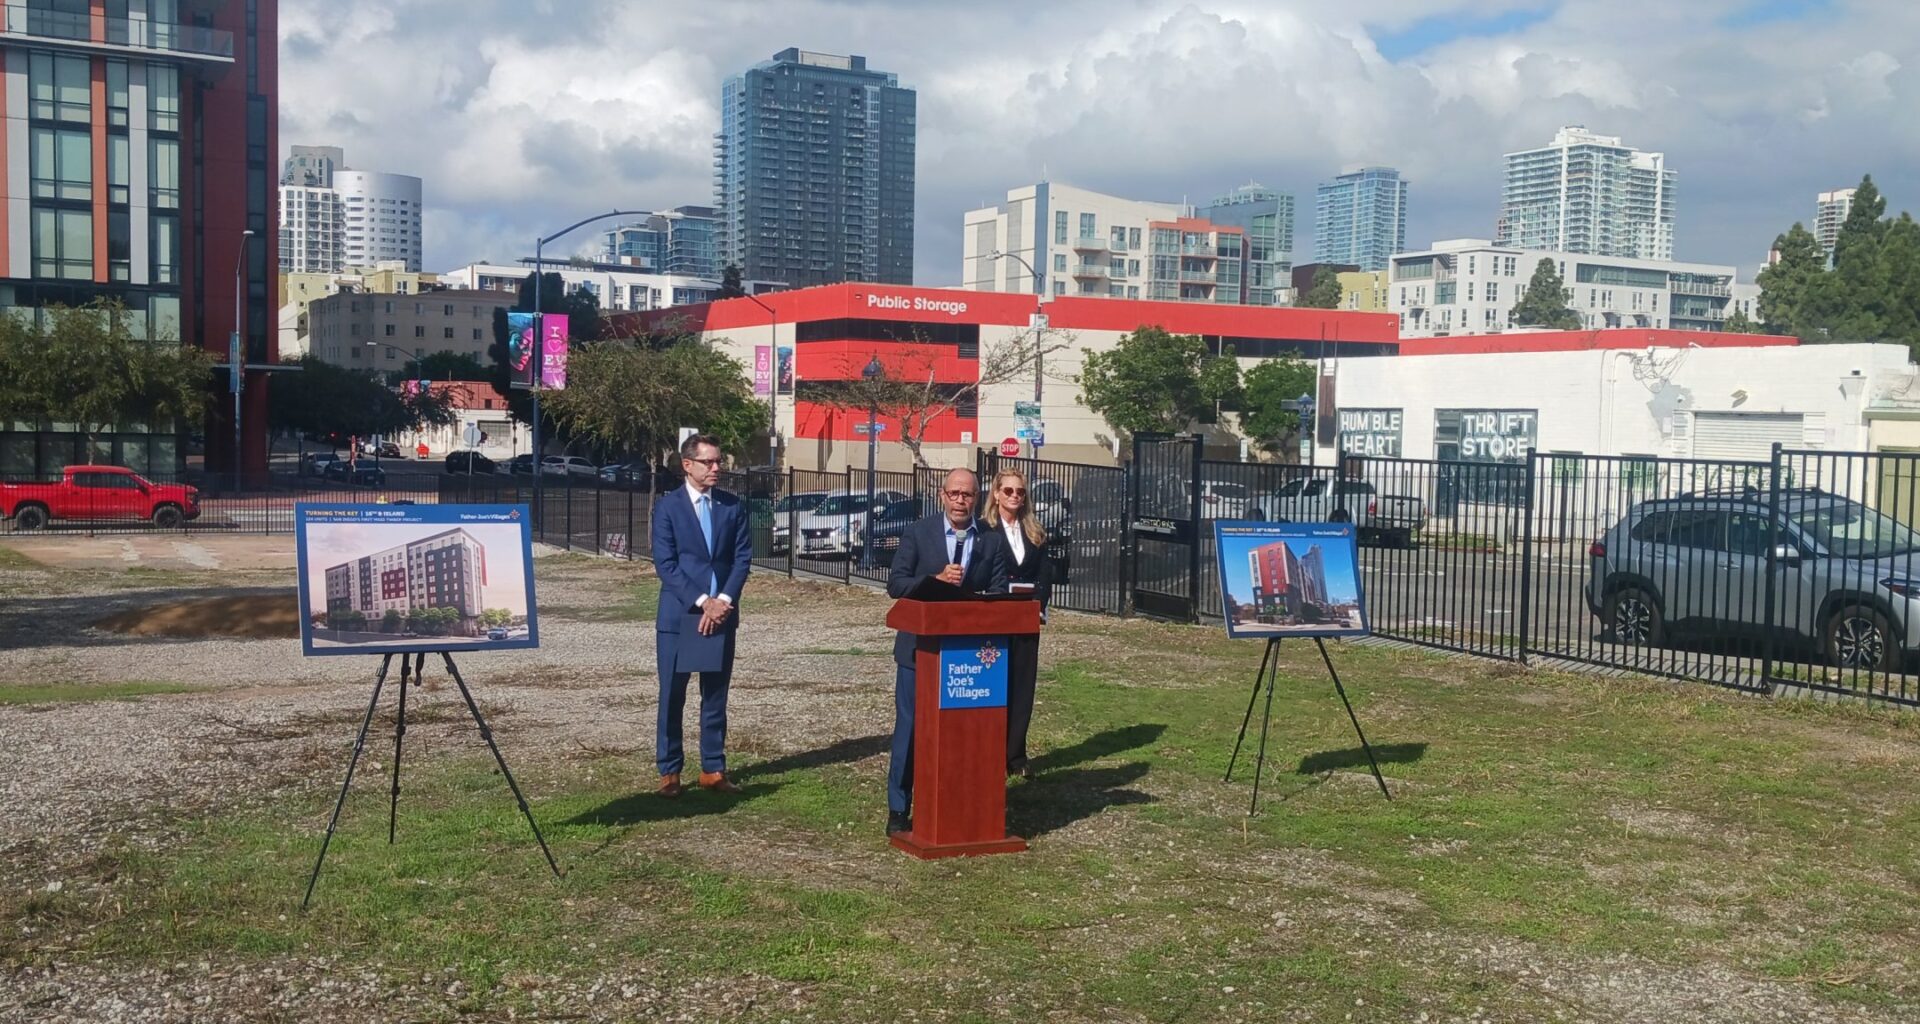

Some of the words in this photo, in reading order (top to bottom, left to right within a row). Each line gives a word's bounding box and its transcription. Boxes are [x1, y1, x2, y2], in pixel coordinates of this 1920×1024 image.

[868, 294, 911, 310] Public
[914, 297, 967, 315] Storage
[1340, 411, 1400, 432] HUMBLE
[1463, 414, 1532, 434] THRIFT
[1001, 443, 1019, 453] STOP
[1343, 434, 1397, 455] HEART
[1462, 436, 1529, 457] STORE
[948, 664, 983, 674] Father
[947, 675, 974, 686] Joe's
[947, 687, 990, 700] Villages
